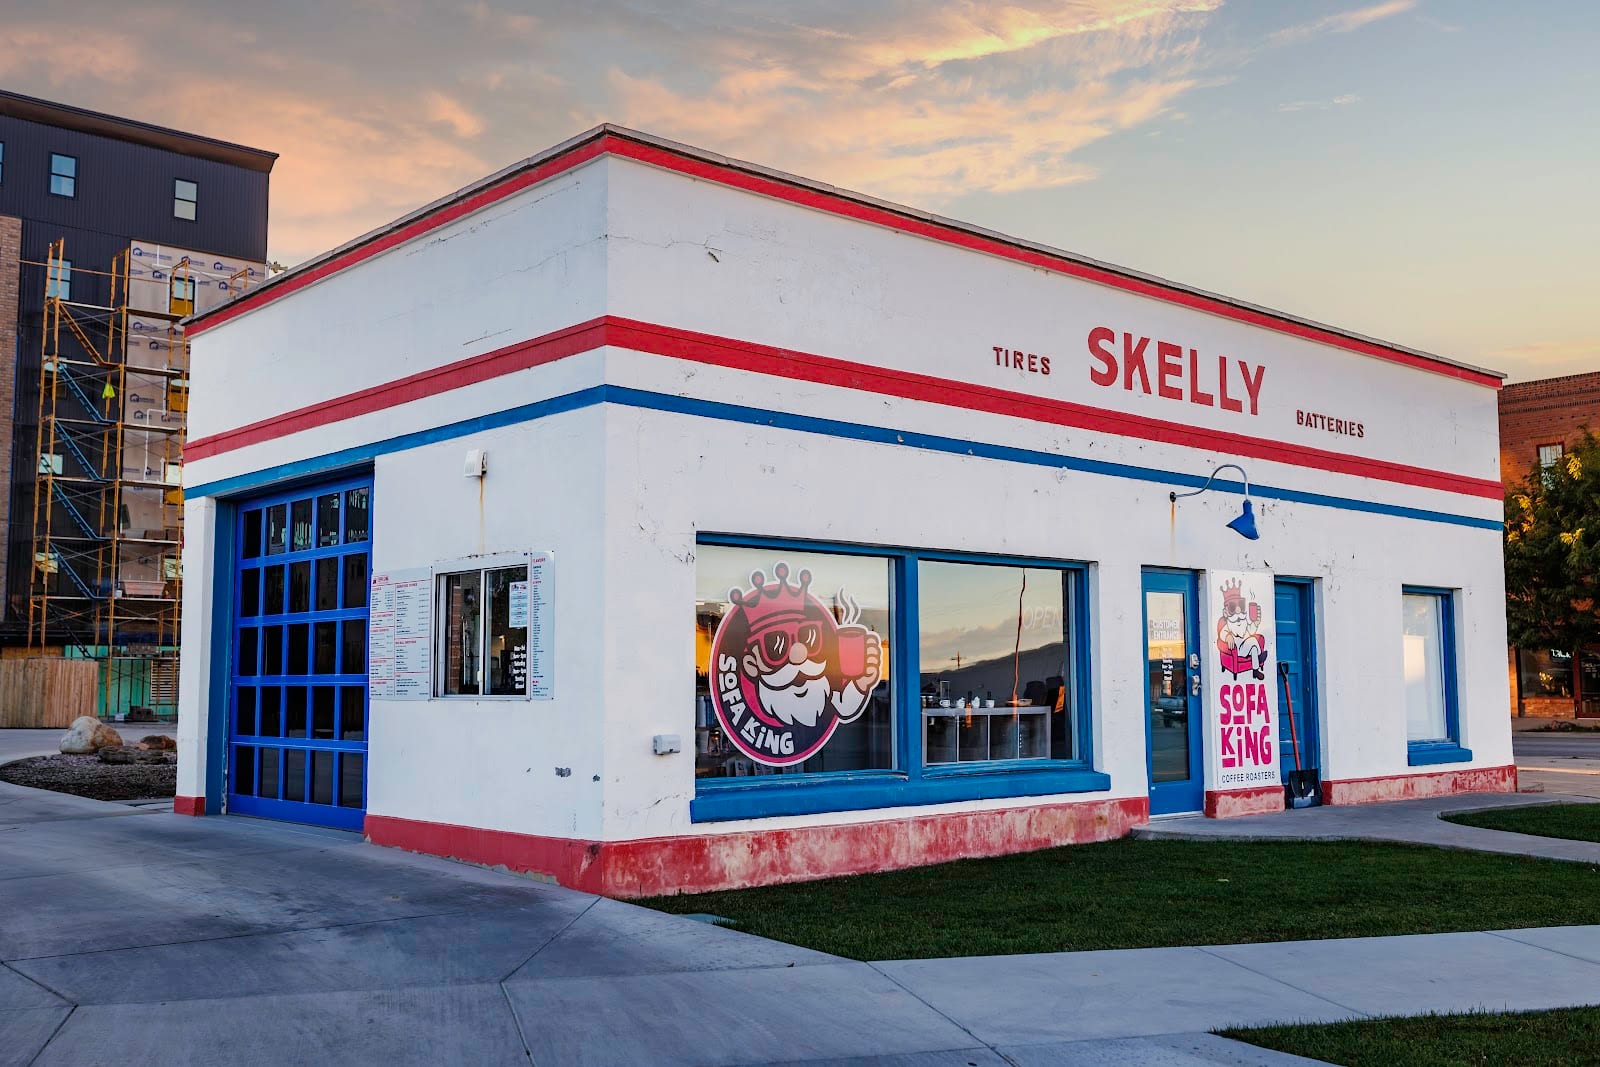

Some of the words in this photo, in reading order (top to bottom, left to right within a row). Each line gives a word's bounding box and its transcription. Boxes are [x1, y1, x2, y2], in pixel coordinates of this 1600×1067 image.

[992, 346, 1051, 375] TIRES
[1087, 326, 1266, 416] SKELLY
[1296, 409, 1365, 438] BATTERIES
[1022, 606, 1062, 630] OPEN
[718, 653, 747, 727] SOFA
[1219, 683, 1271, 726] SOFA
[1221, 772, 1244, 783] COFFEE
[1245, 770, 1276, 782] ROASTERS
